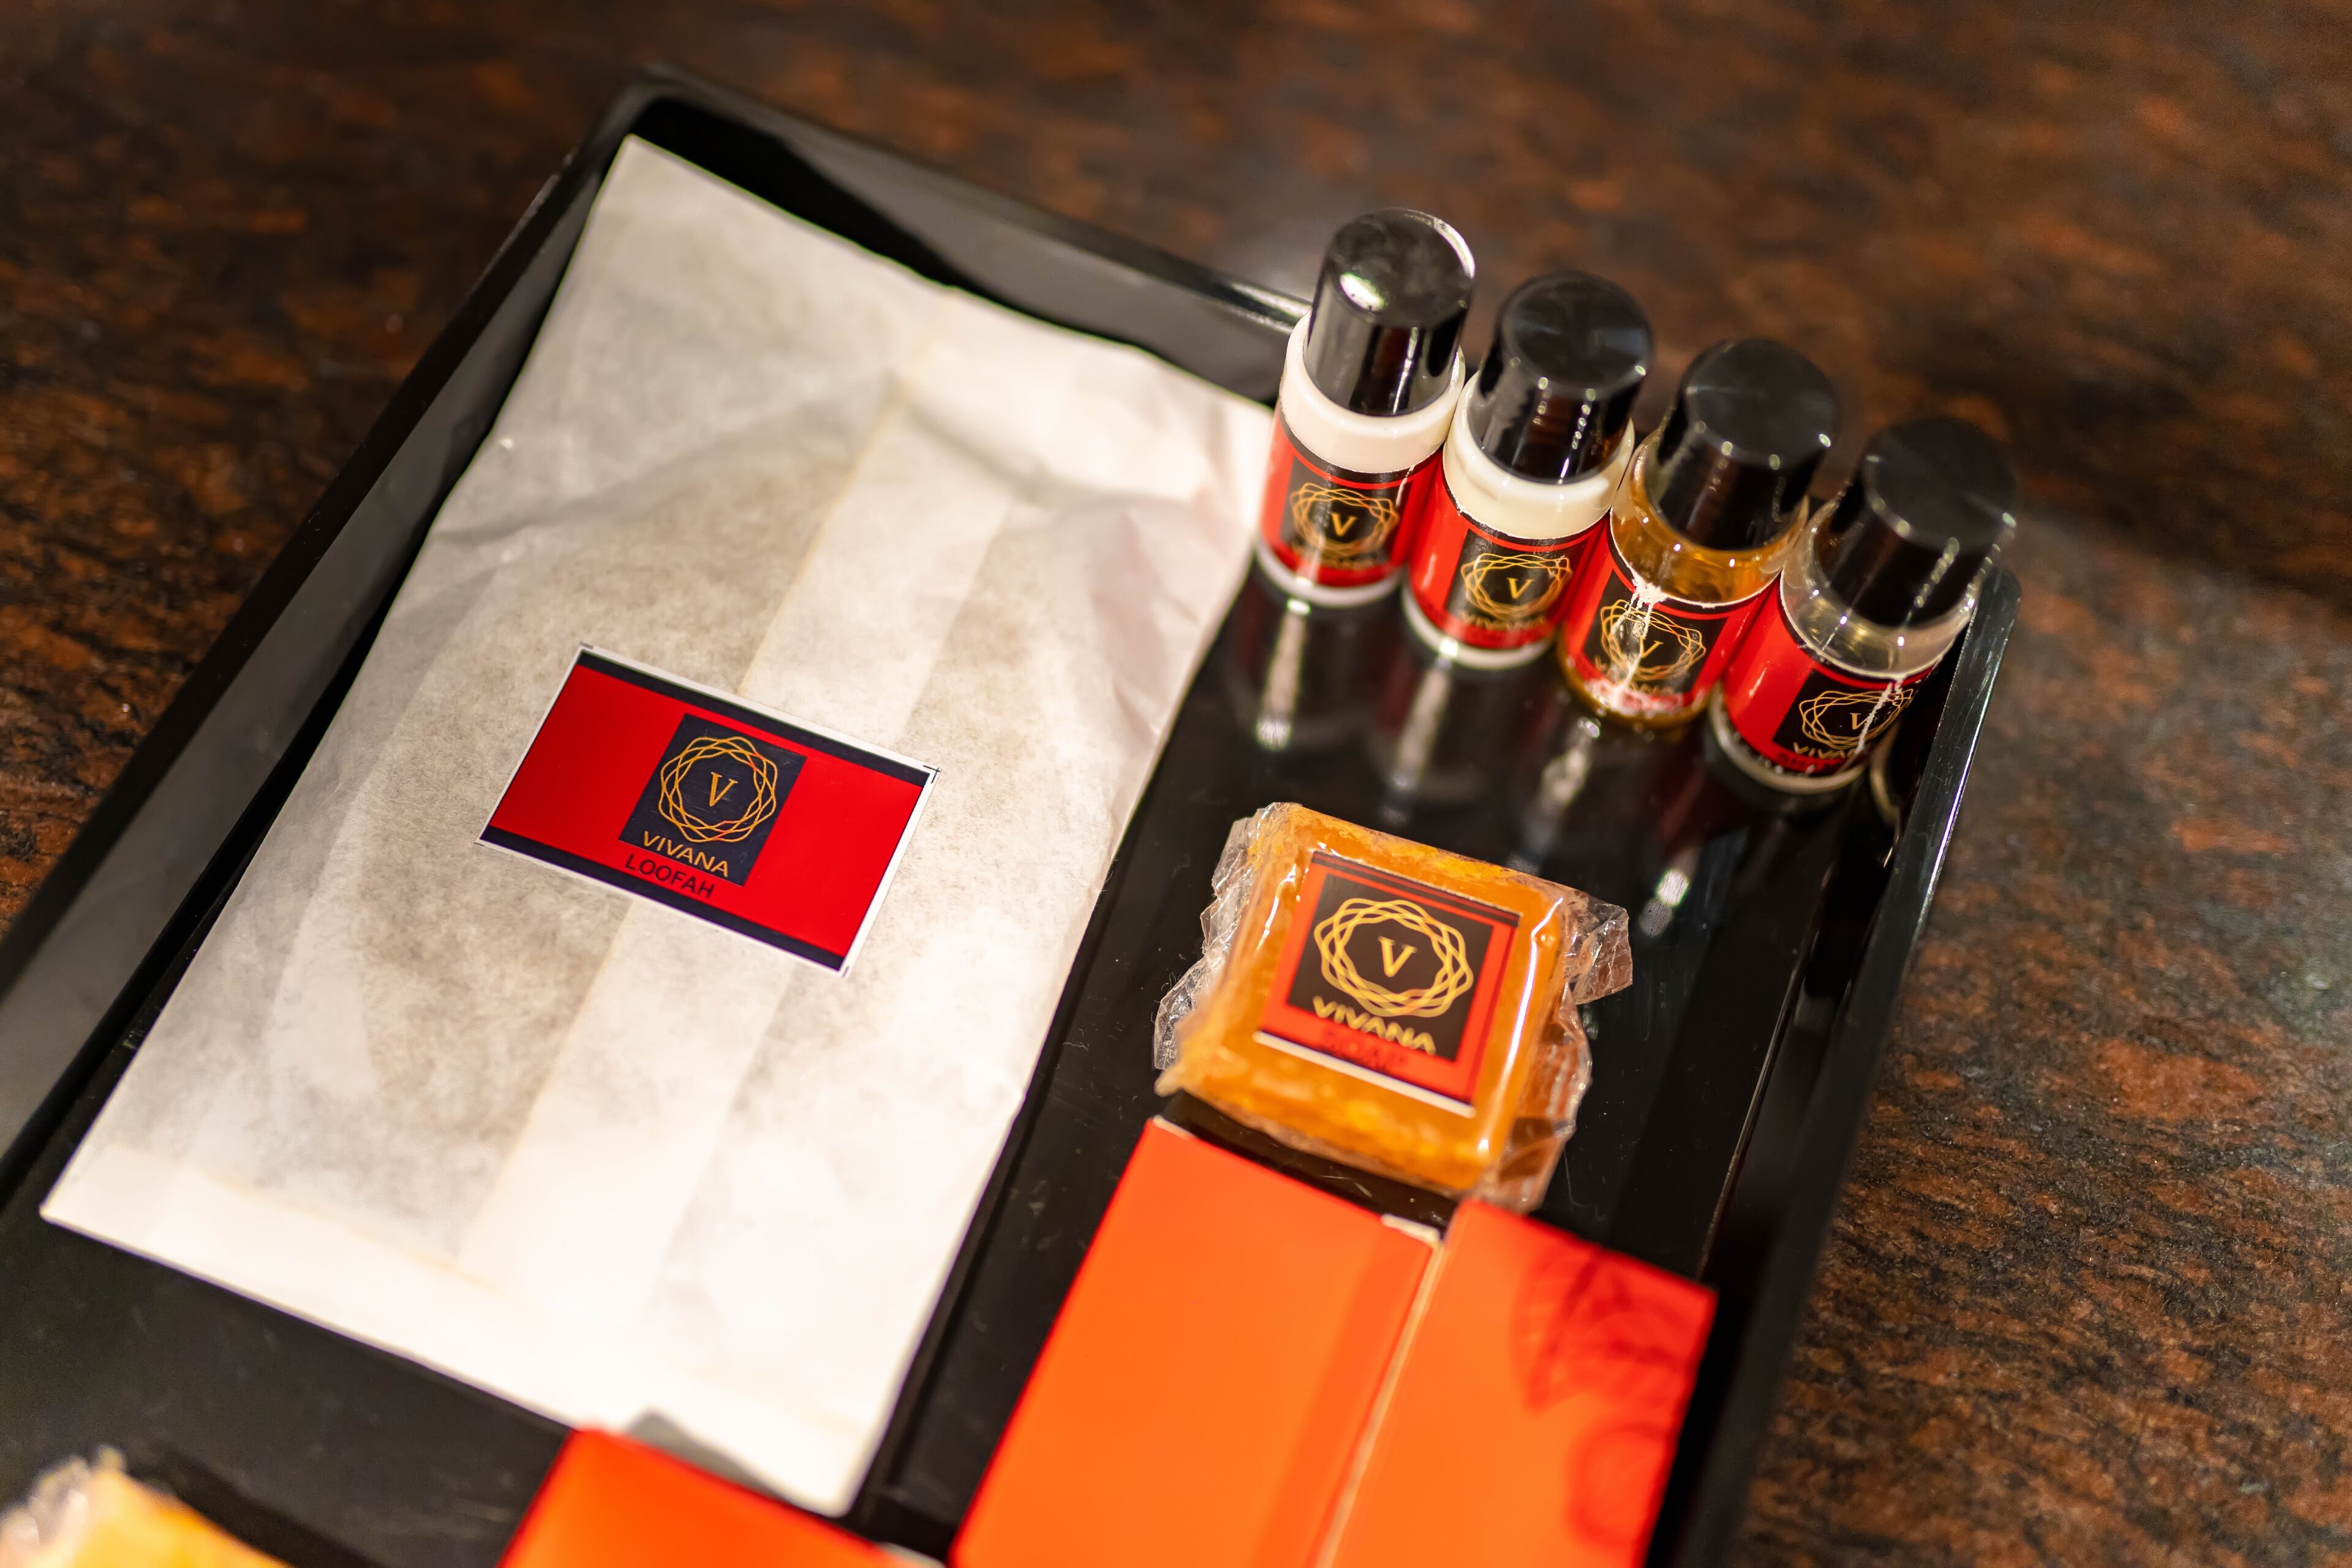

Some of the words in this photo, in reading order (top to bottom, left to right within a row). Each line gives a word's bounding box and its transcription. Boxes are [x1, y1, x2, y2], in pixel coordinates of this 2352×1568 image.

[1332, 513, 1358, 537] V
[1506, 577, 1534, 600] V
[1638, 635, 1664, 658] V
[709, 771, 738, 807] V
[644, 831, 729, 878] VIVANA
[625, 853, 715, 899] LOOFAH
[1378, 936, 1418, 978] V
[1313, 995, 1437, 1056] VIVANA
